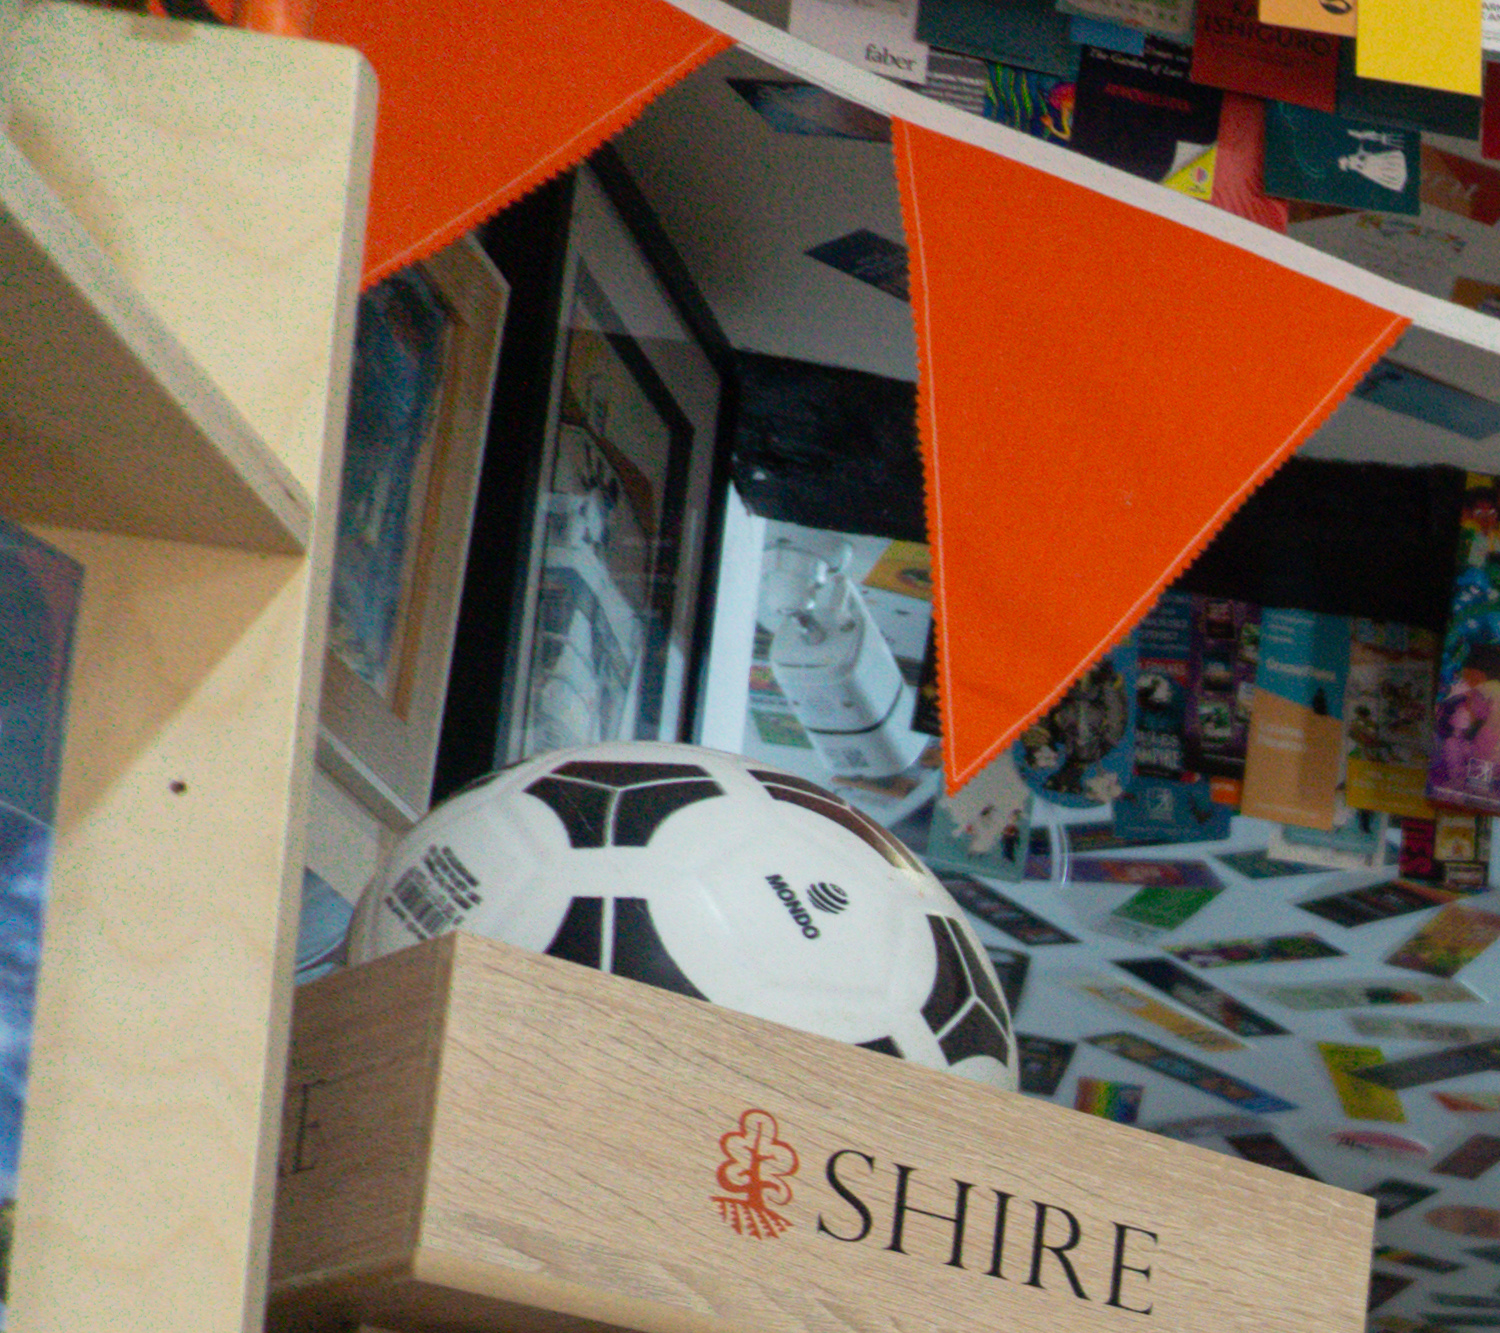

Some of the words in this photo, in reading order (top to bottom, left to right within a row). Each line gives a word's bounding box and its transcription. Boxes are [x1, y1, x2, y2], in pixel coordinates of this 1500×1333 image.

[864, 42, 917, 74] faber
[765, 871, 821, 943] MONDO
[816, 1148, 1160, 1317] SHIRE
